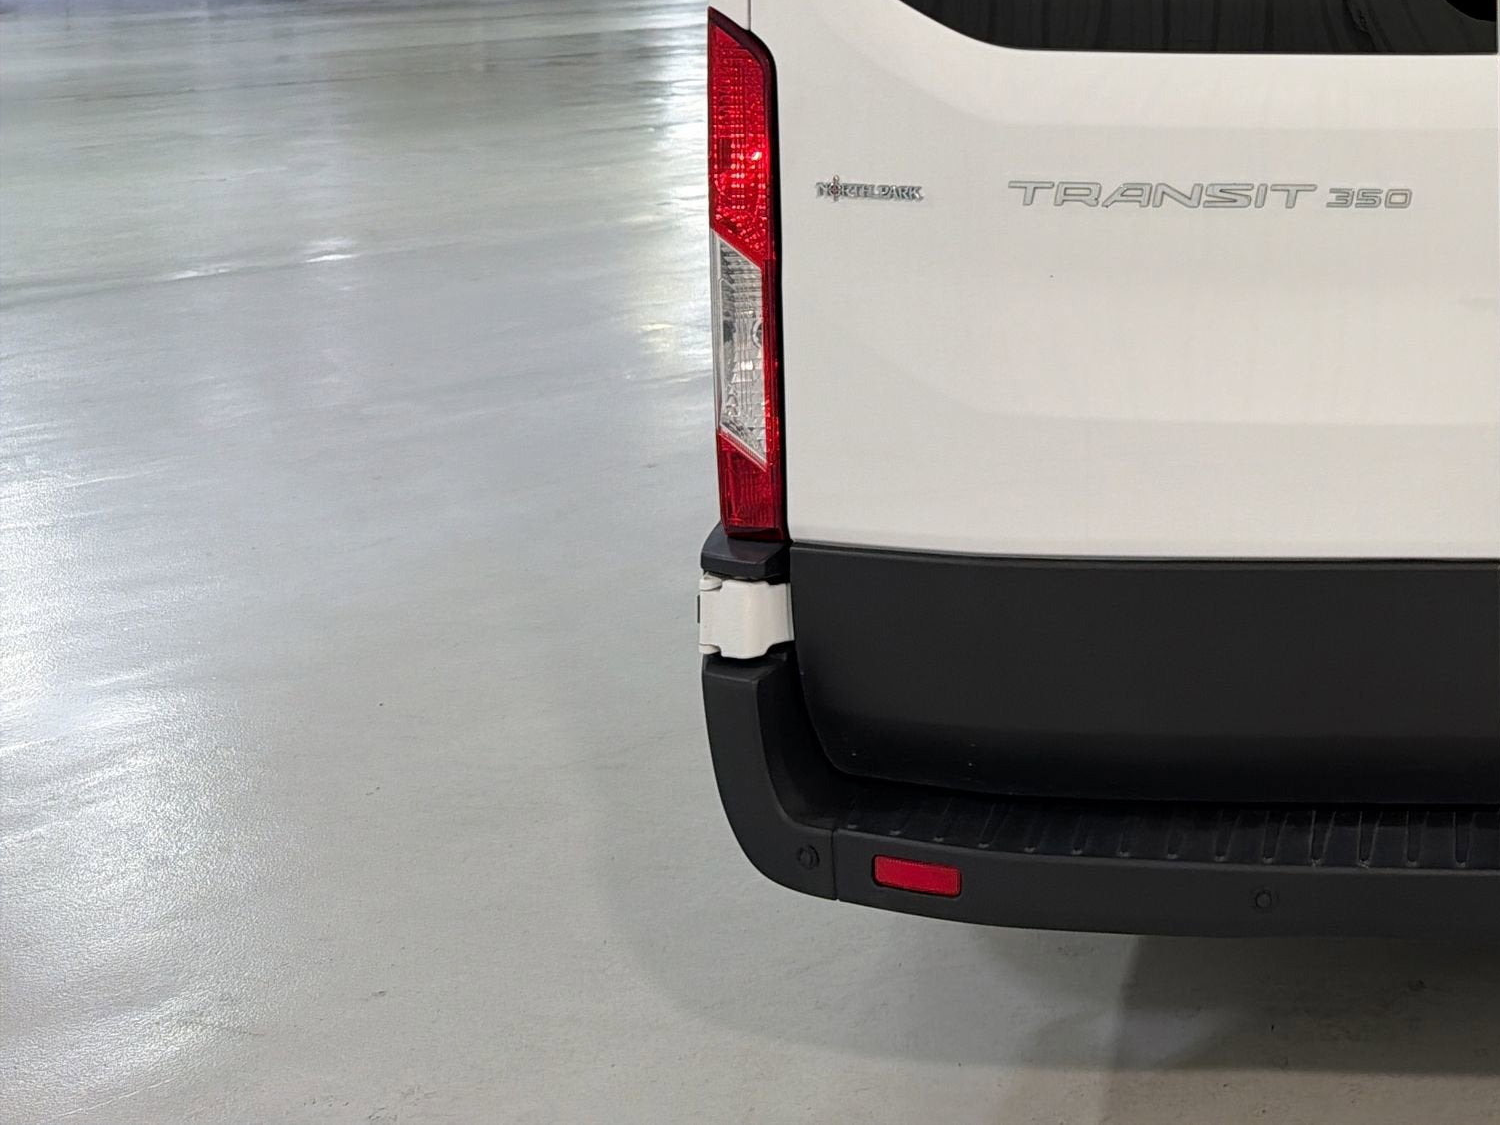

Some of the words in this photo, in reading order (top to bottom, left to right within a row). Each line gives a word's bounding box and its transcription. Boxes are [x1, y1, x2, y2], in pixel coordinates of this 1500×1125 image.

[877, 184, 924, 201] PARK
[1008, 180, 1317, 208] TRANSIT
[1326, 187, 1412, 209] 350
